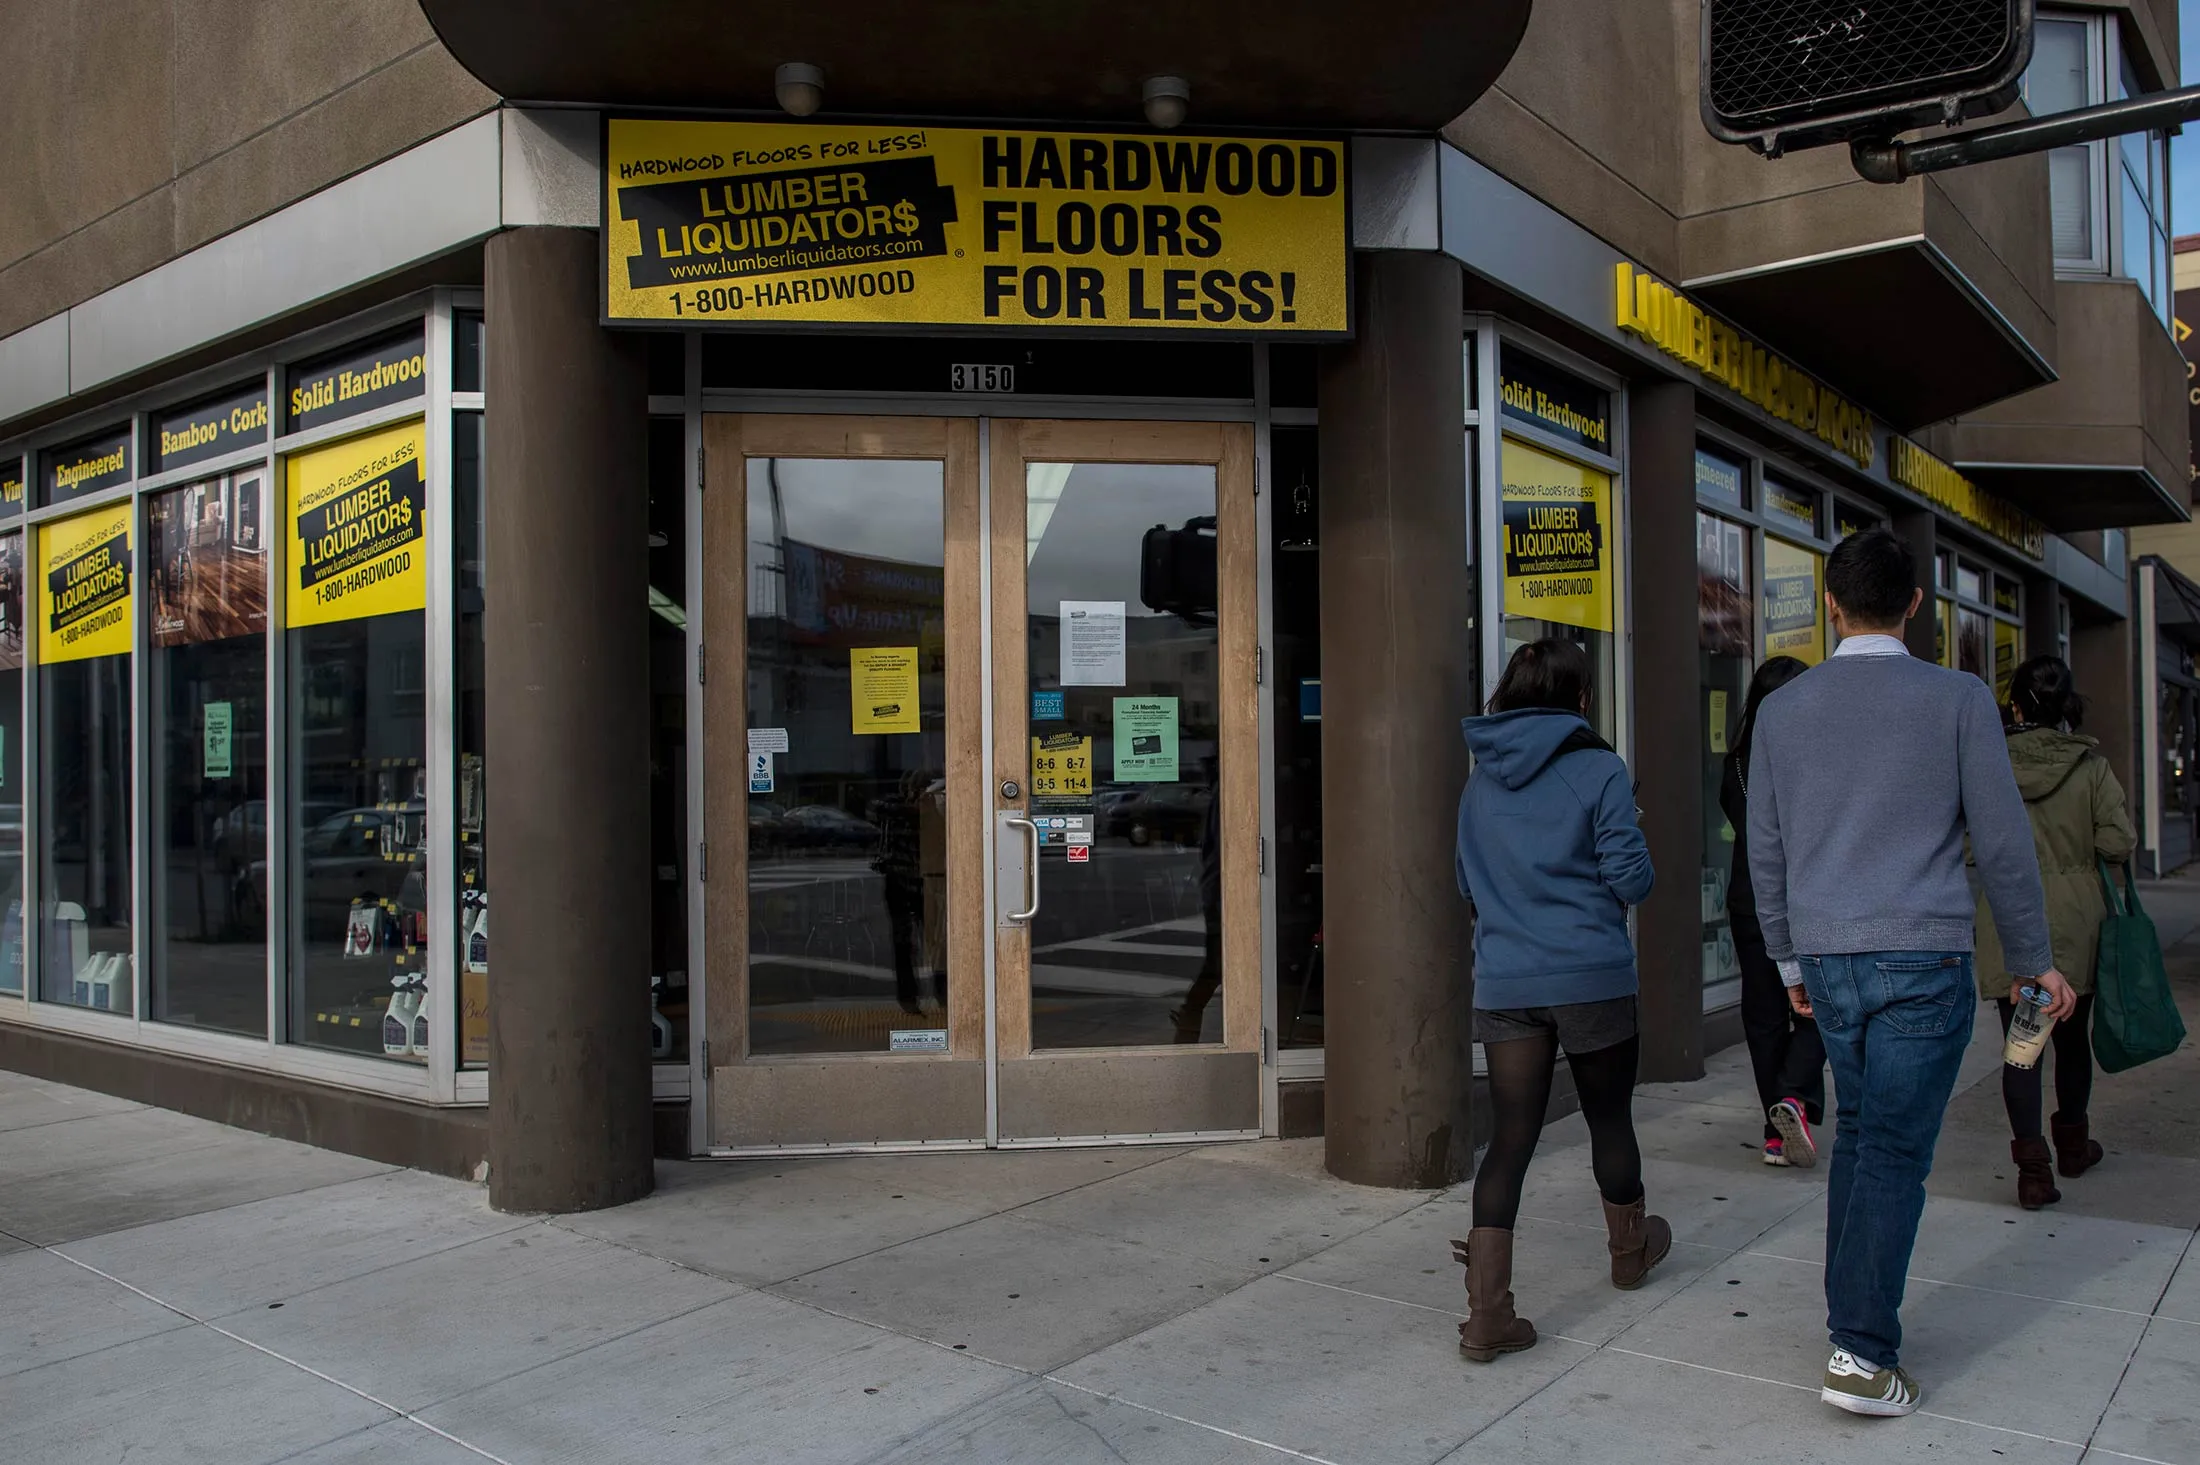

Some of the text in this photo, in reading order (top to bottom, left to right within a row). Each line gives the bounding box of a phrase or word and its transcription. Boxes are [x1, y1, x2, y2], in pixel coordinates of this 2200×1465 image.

[620, 131, 927, 179] HARDWOOD FLOORS FOR LESS!
[982, 136, 1337, 198] HARDWOOD
[700, 172, 868, 218] LUMBER
[983, 200, 1222, 259] FLOORS
[669, 238, 923, 279] www.lumberliquidators.com
[669, 269, 915, 315] 1-800-HARDWOOD
[984, 265, 1296, 324] FOR LESS!
[292, 376, 335, 416] Solid
[952, 365, 1013, 391] 3150
[161, 401, 268, 456] Bamboo Cork
[1536, 390, 1605, 443] Hardwood
[56, 446, 124, 489] Engineered
[297, 440, 416, 512] HARDWOOD FLOORS FOR LESS!
[325, 479, 391, 531] LUMBER
[1502, 484, 1536, 497] HARDWOOD
[1538, 485, 1562, 497] FLOORS
[1564, 485, 1575, 497] FOR
[1528, 507, 1578, 530] LUMBER
[66, 547, 110, 587] LUMBER
[314, 526, 414, 580] www.lumberliquidators.com
[1519, 558, 1595, 574] www.lumberliquidators.com
[315, 551, 411, 606] 1-800-HARDWOOD
[1520, 577, 1593, 599] 1-800-HARDWOOD
[1776, 580, 1805, 599] LUMBER
[60, 606, 123, 647] 1-800-HARDWOOD
[1034, 699, 1061, 707] BEST
[1036, 758, 1055, 769] 8-6
[1037, 778, 1055, 789] 9-5
[1064, 778, 1086, 789] 11-4
[1067, 758, 1085, 769] 8-7
